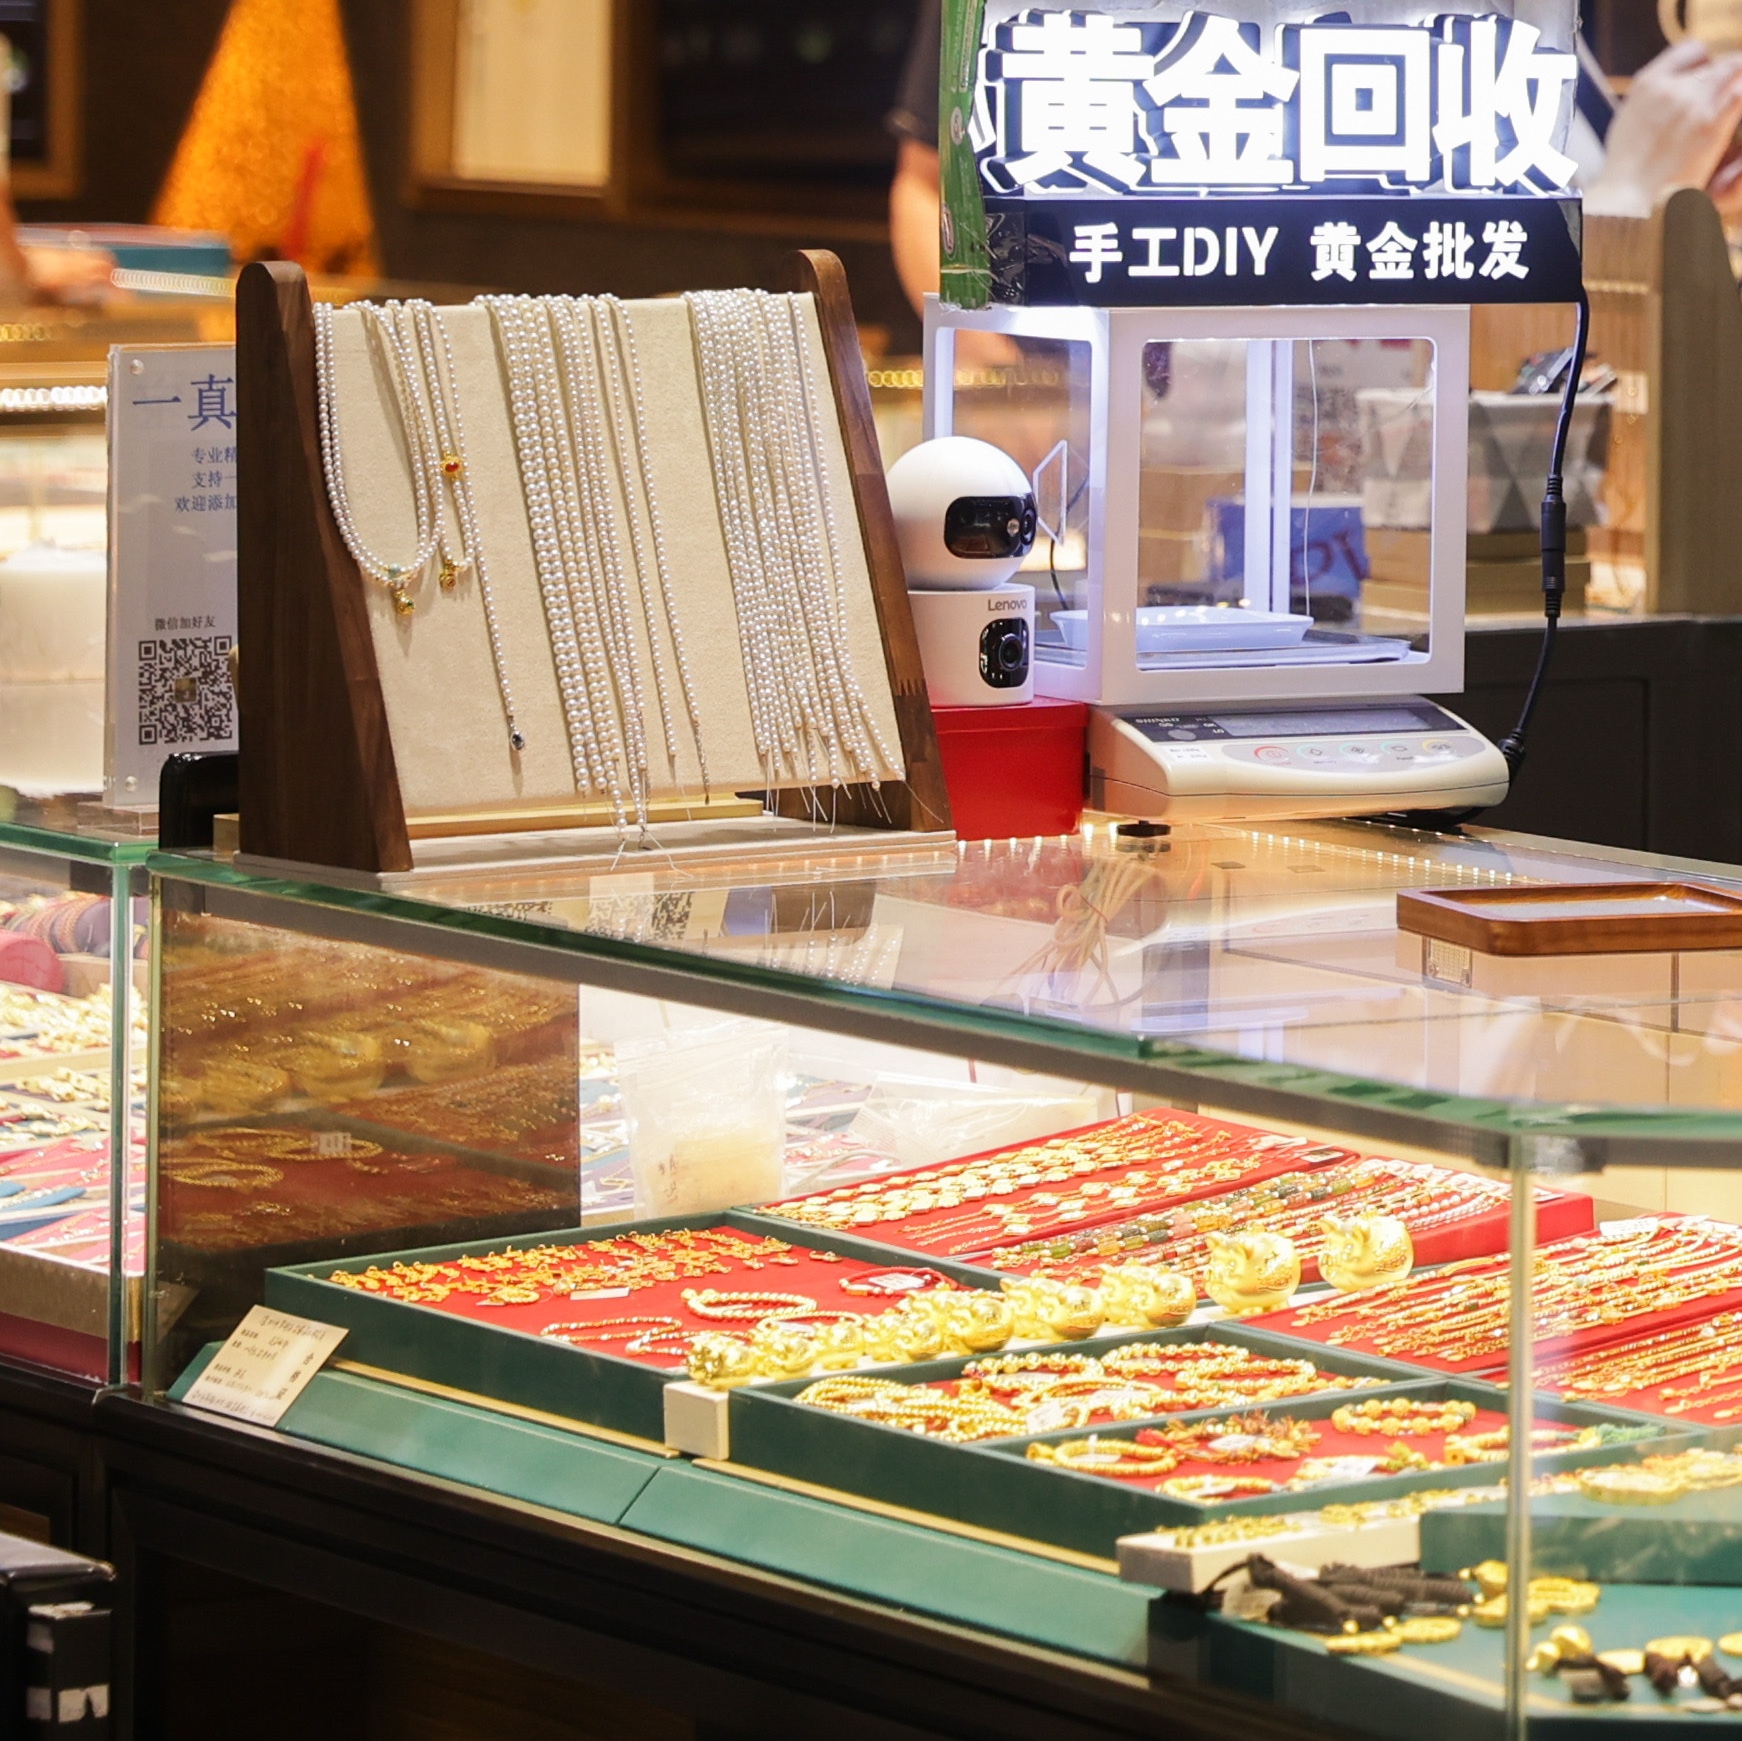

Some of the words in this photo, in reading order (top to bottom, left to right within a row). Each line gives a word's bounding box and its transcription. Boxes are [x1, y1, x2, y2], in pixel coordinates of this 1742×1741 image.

[988, 12, 1579, 194] 黄金回收
[1069, 222, 1279, 284] 手工DIY
[1309, 220, 1530, 282] 黄金批发
[988, 598, 1028, 612] Lenovo
